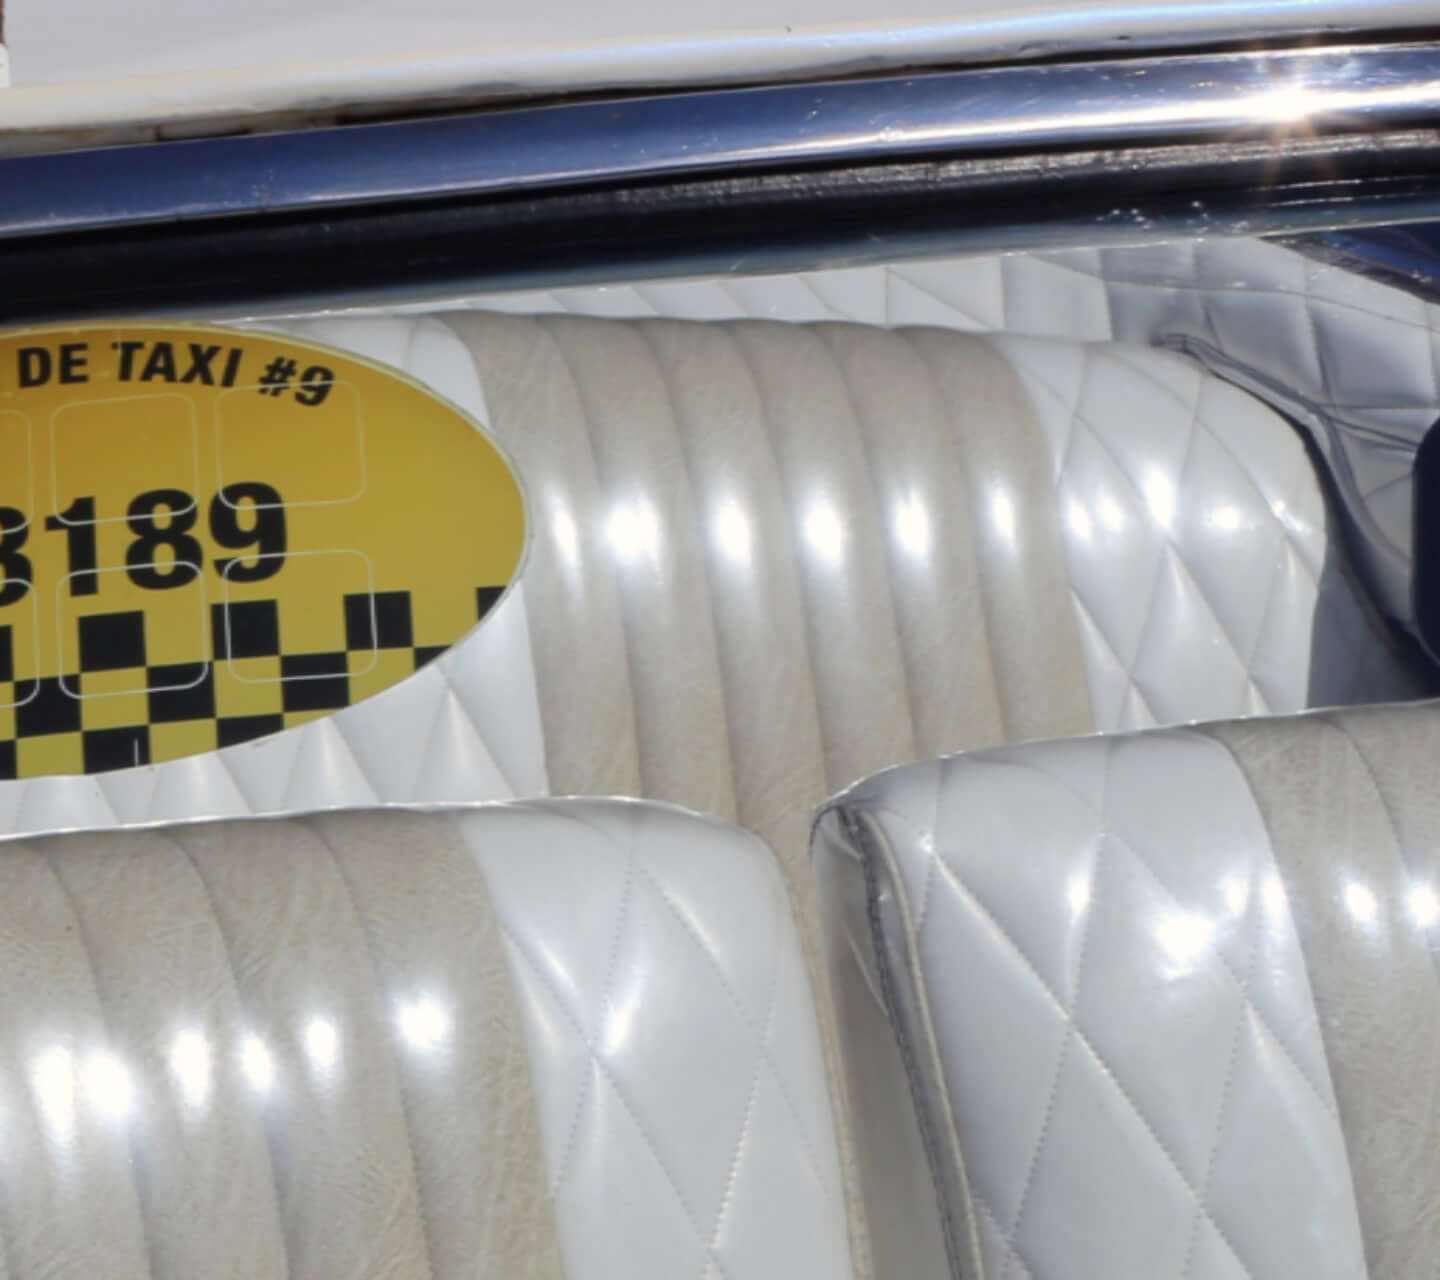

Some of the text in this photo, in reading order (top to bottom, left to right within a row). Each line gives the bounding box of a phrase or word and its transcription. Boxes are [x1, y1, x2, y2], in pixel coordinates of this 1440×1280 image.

[16, 340, 90, 390] DE
[115, 339, 244, 390] TAXI
[258, 354, 336, 410] #9
